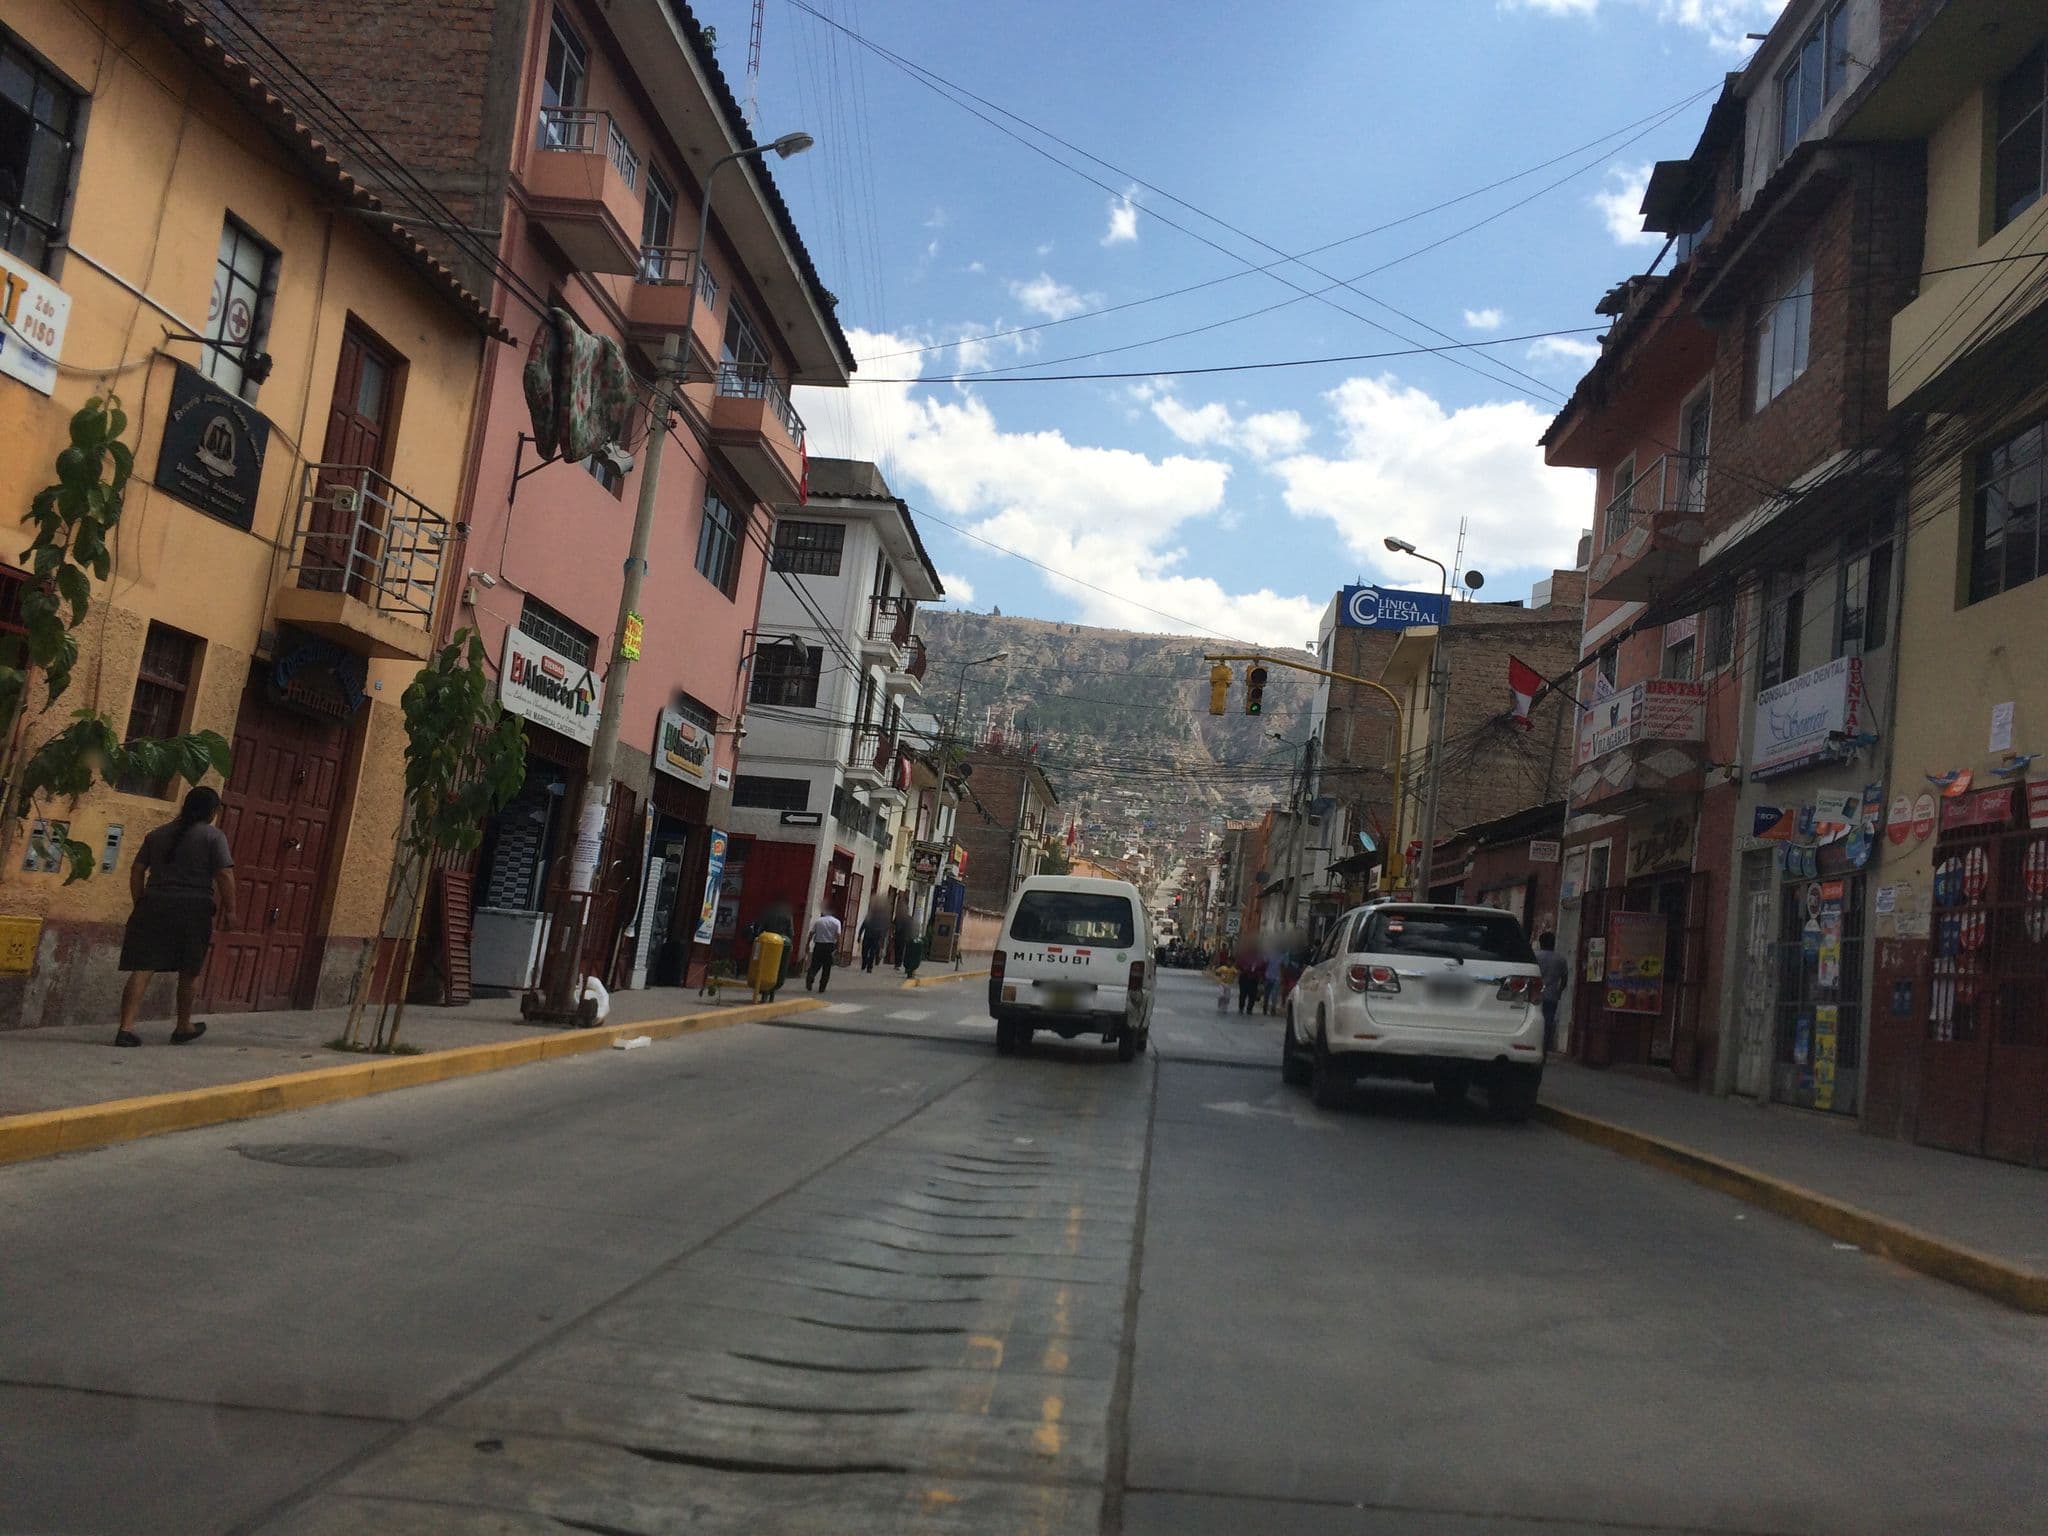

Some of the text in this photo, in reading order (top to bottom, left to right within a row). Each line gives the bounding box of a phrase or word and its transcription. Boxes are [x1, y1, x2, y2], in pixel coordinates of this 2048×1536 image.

[23, 314, 56, 347] PISO
[524, 659, 576, 710] Almacén
[1646, 681, 1704, 697] DENTAL
[1758, 661, 1846, 705] CONSULTORIO DENTAL
[1228, 918, 1239, 928] 20
[1013, 951, 1091, 966] MITSUBI
